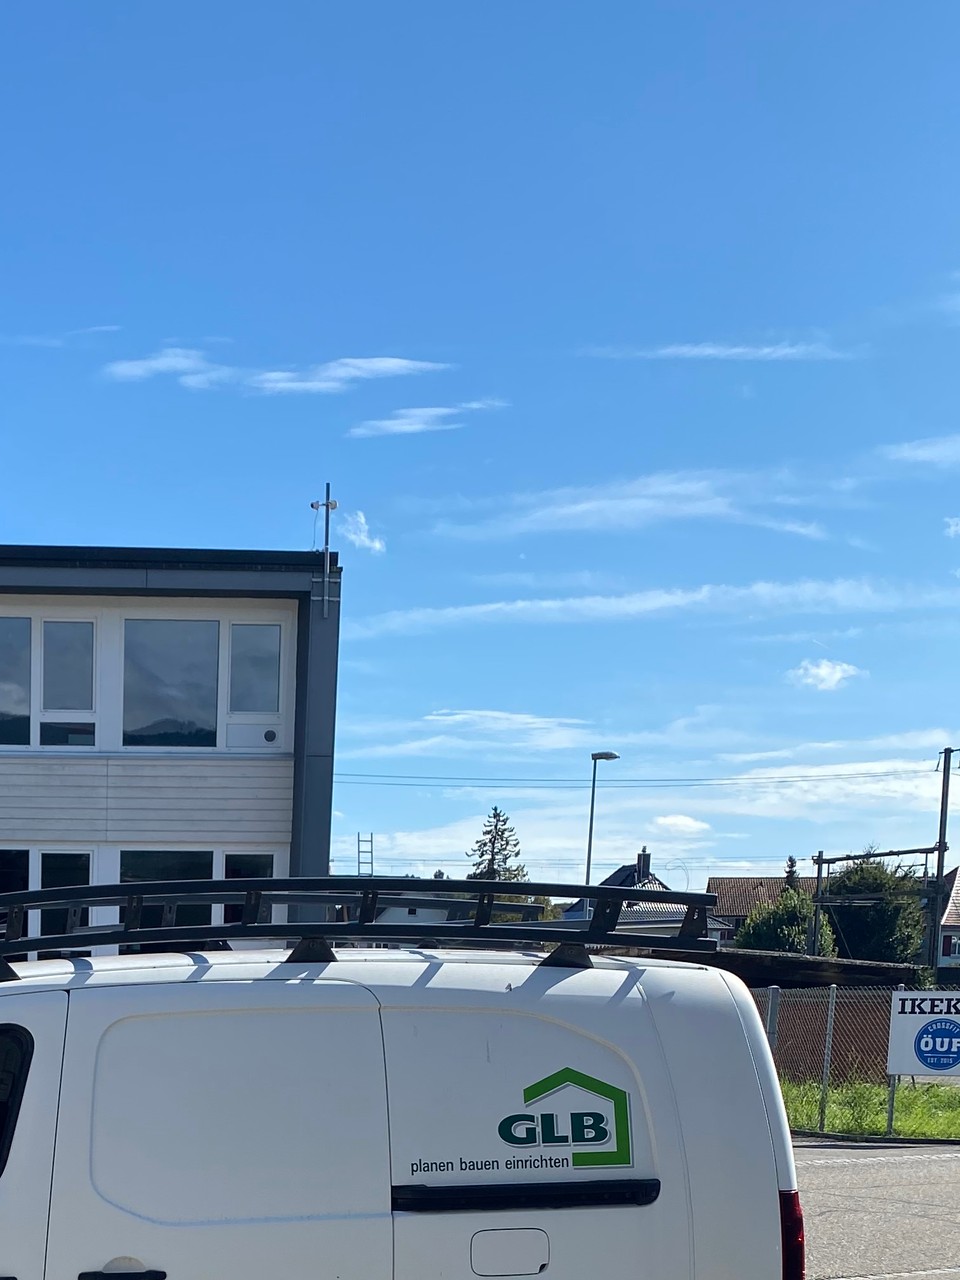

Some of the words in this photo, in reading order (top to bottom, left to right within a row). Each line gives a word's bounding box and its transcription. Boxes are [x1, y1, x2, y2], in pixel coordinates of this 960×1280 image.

[497, 1111, 610, 1147] GLB
[411, 1159, 454, 1175] planen
[459, 1157, 500, 1171] bauen
[504, 1155, 570, 1170] einrichten
